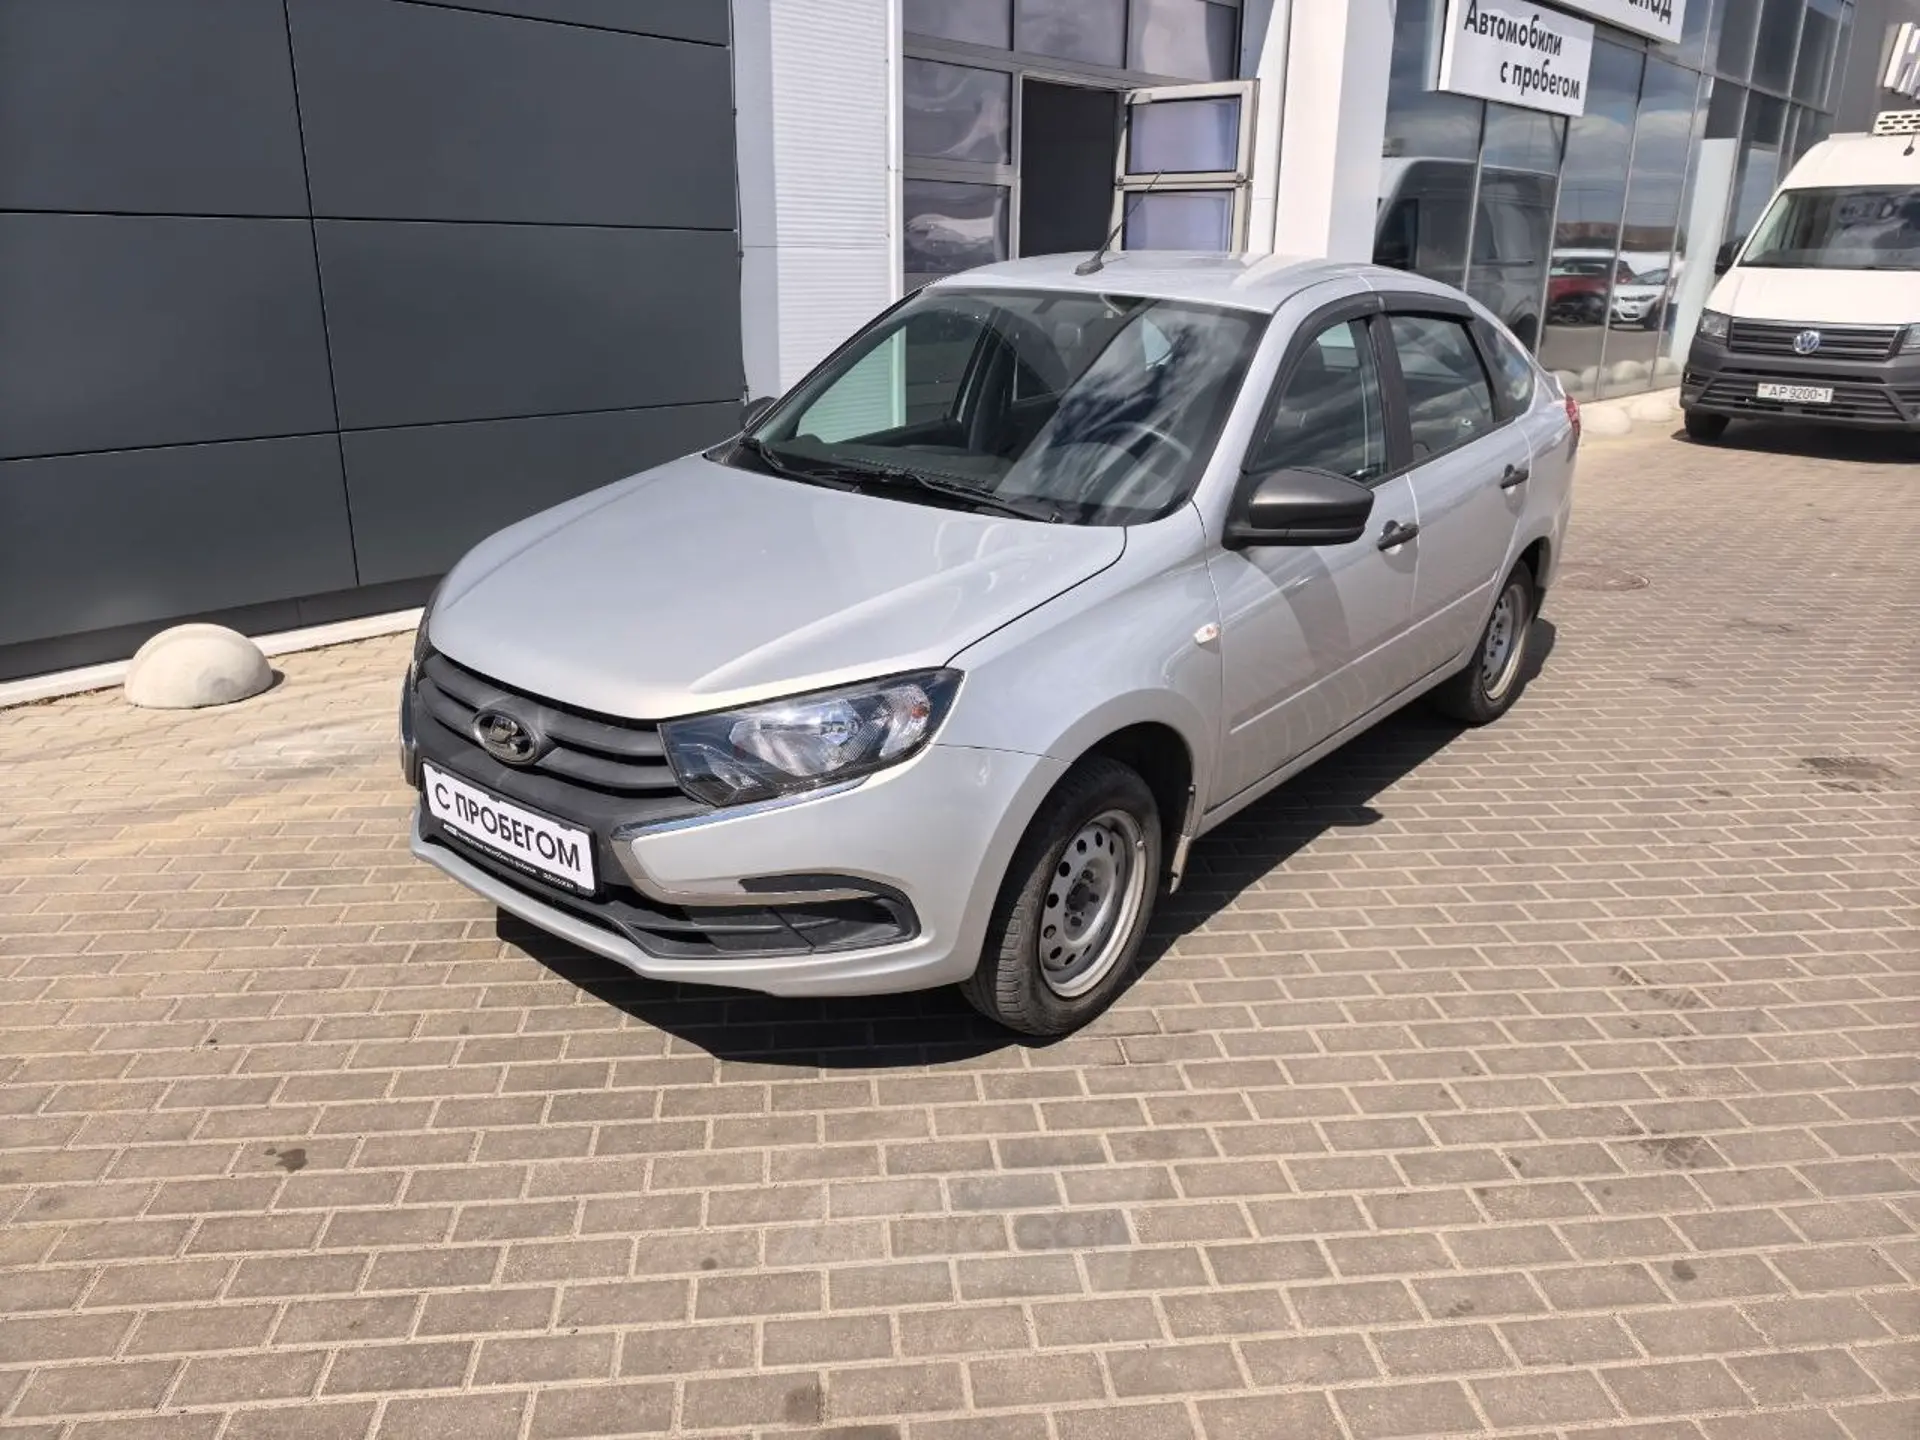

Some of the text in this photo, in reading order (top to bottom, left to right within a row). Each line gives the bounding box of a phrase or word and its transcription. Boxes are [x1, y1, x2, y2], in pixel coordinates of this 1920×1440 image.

[1464, 0, 1562, 56] Автомобили
[1500, 58, 1580, 100] с пробегом
[434, 783, 451, 810] С
[454, 791, 581, 872] ПРОБЕГОМ
